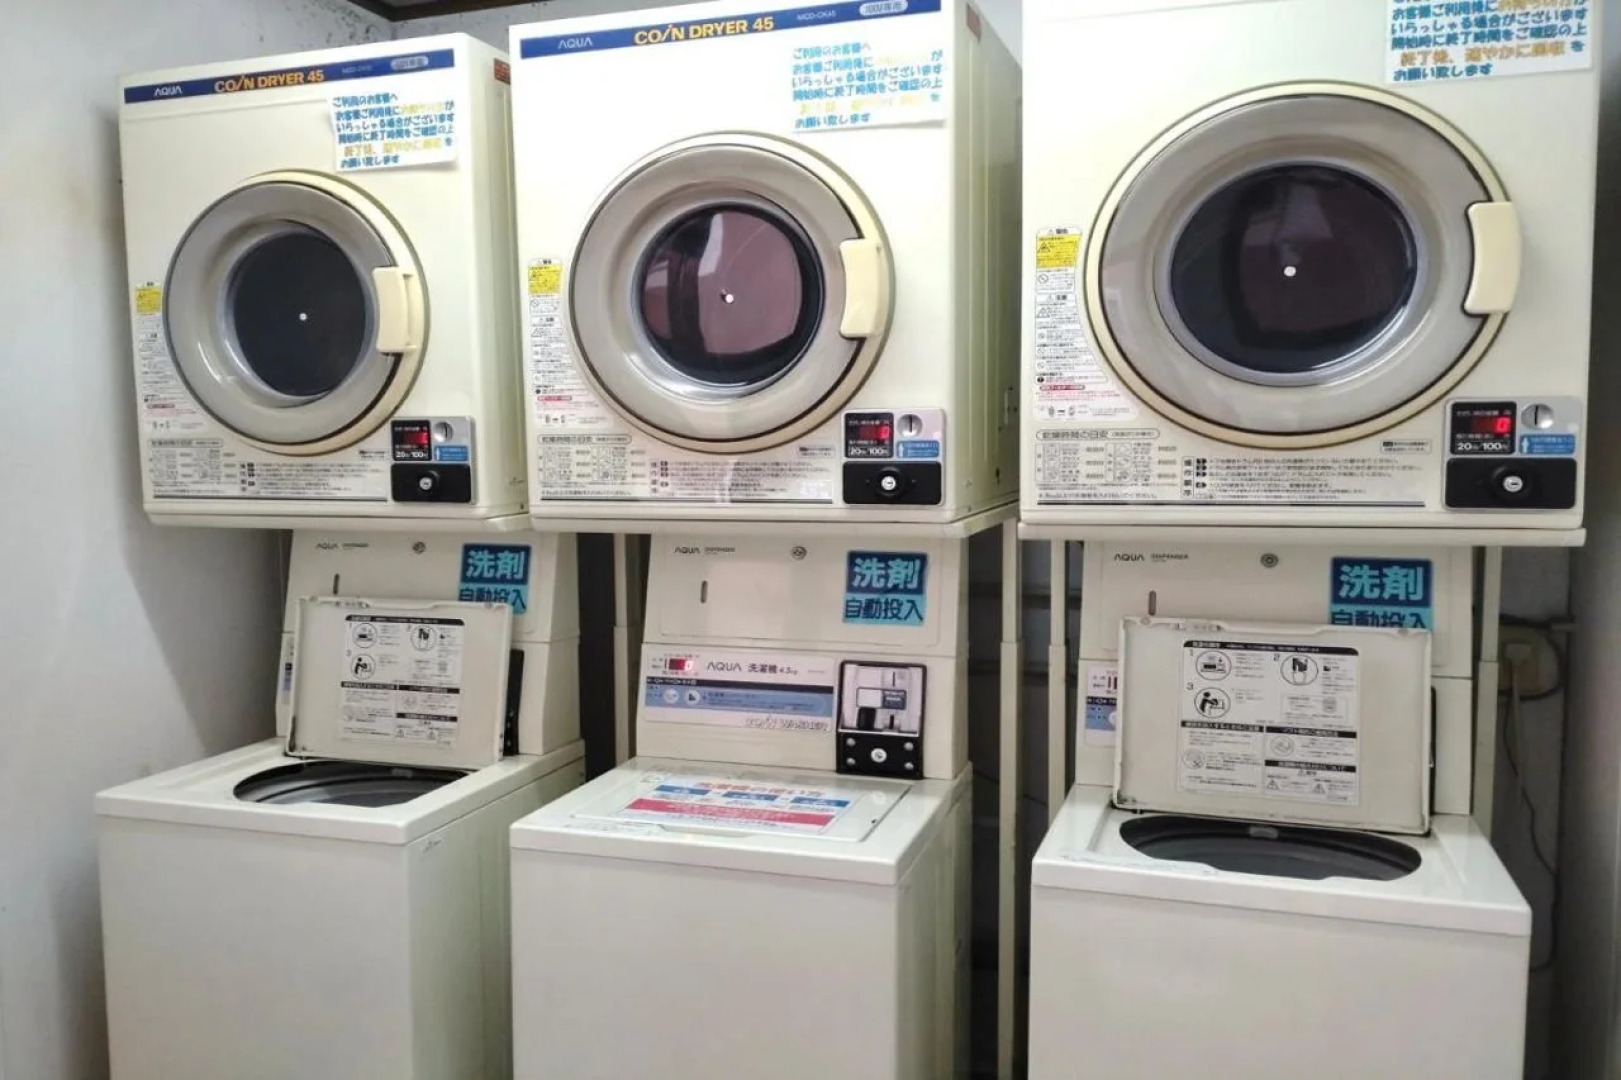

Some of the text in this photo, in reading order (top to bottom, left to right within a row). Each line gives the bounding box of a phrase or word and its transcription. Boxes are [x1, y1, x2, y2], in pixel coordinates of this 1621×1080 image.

[557, 37, 593, 50] AQUA
[689, 18, 748, 38] DRYER
[752, 17, 775, 31] 45
[1391, 8, 1588, 36] いらっしゃる場合がございます
[154, 85, 182, 98] AQUA
[257, 71, 305, 89] DRYER
[308, 69, 324, 82] 45
[1393, 62, 1494, 82] お願い致します
[795, 113, 871, 129] お願い致します
[1495, 416, 1511, 434] 0
[674, 546, 701, 555] AQUA
[1113, 552, 1145, 562] AQUA
[466, 550, 525, 579] 洗剤
[852, 557, 921, 590] 洗剤
[1339, 564, 1424, 601] 洗剤
[844, 598, 924, 622] 自動投入
[707, 662, 742, 673] AQUA
[748, 663, 778, 675] 洗濯機
